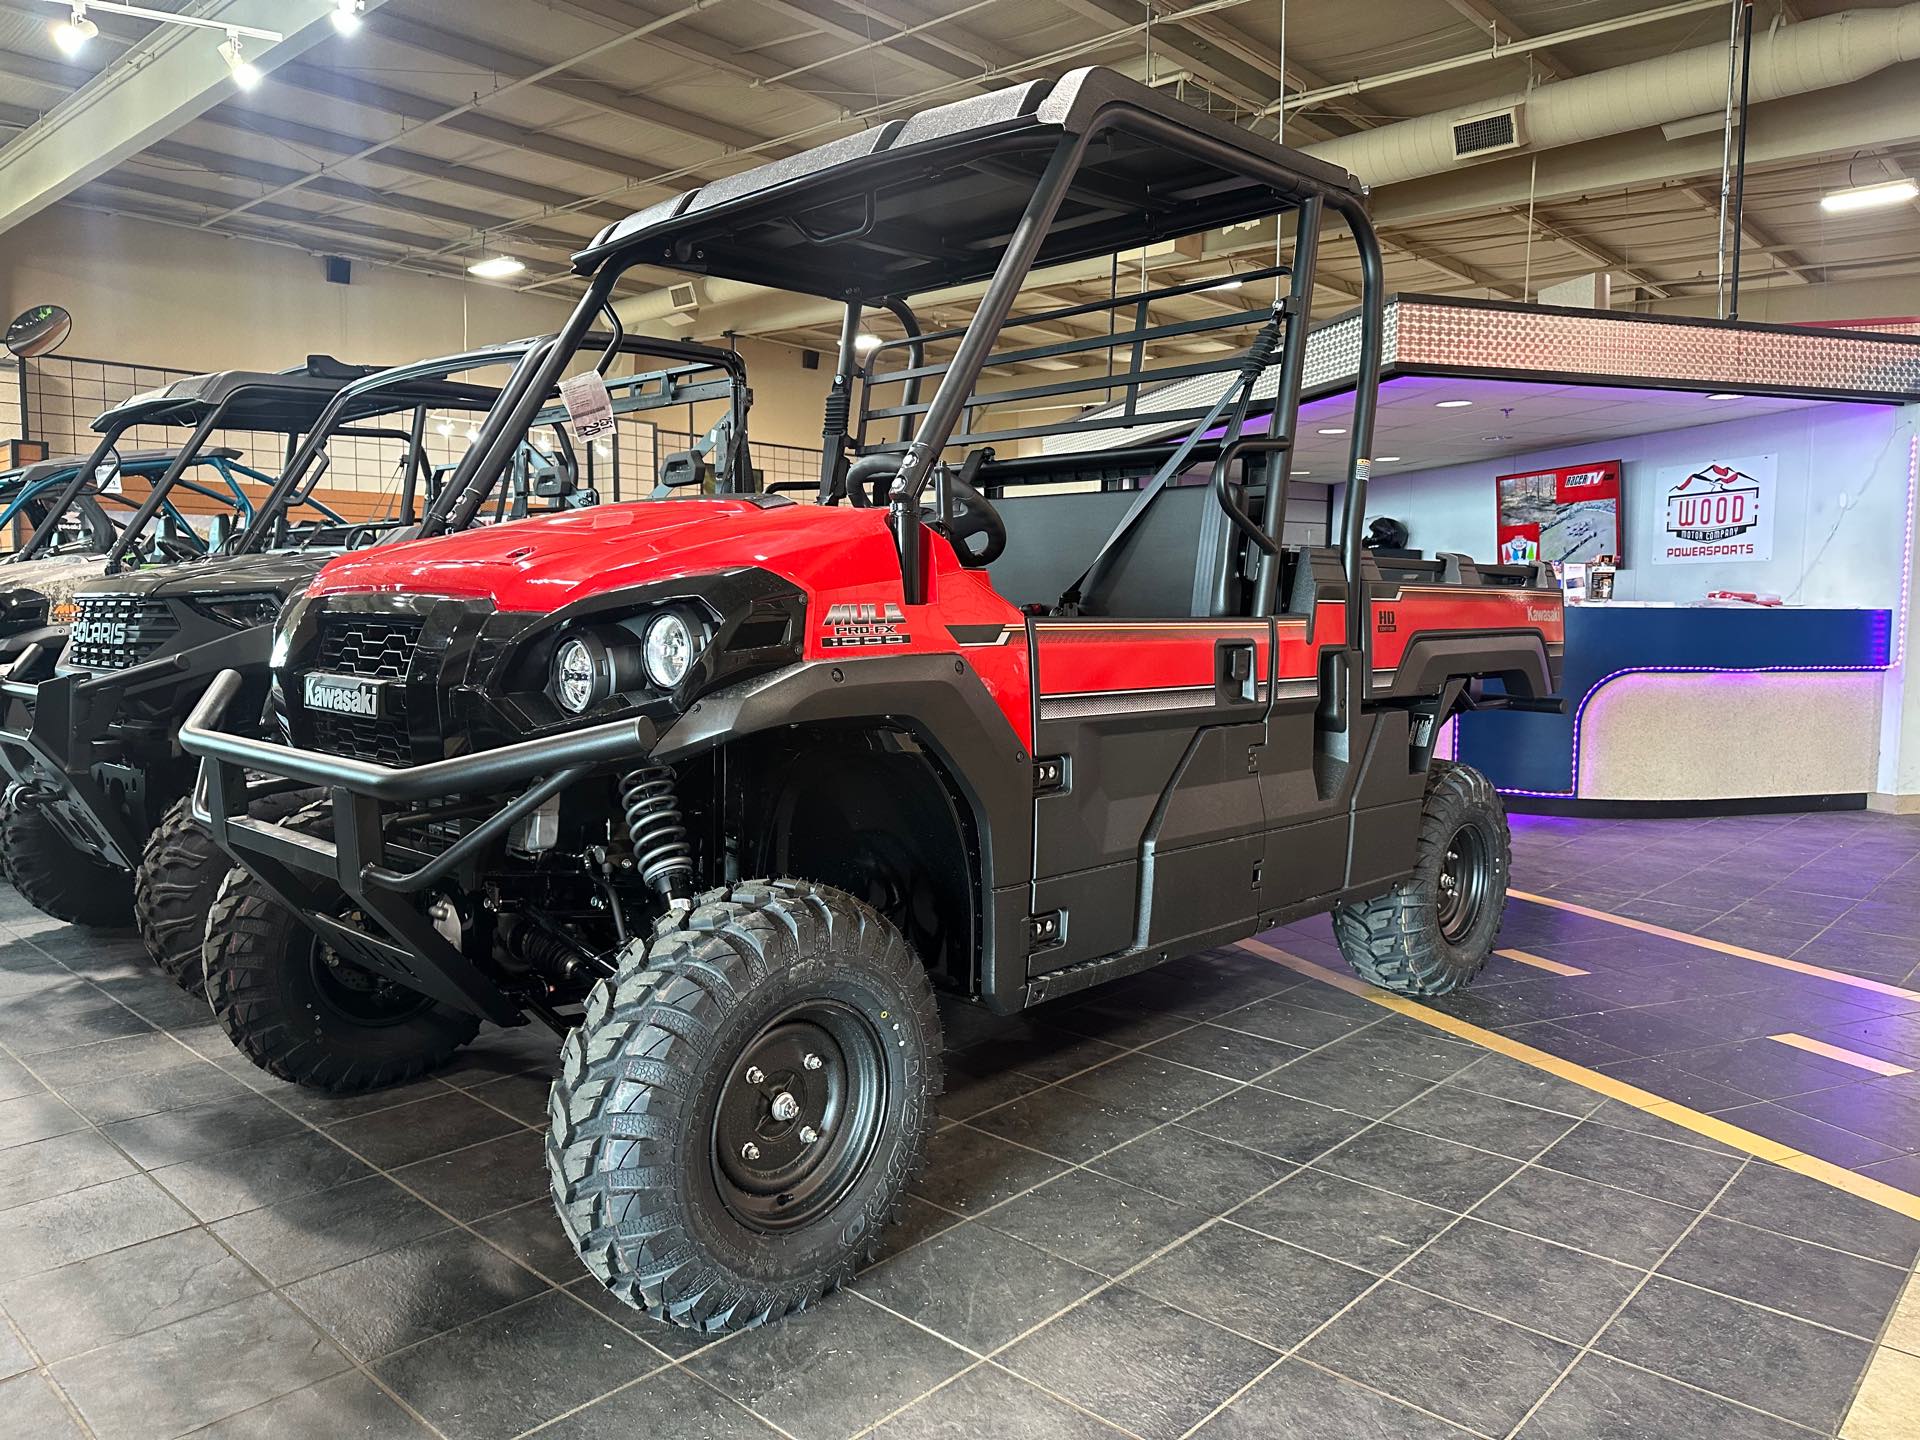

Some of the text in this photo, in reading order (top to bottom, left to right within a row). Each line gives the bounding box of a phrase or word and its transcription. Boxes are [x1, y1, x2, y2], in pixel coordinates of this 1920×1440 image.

[1678, 495, 1745, 527] WOOD
[1680, 526, 1739, 541] MOTOR COMPANY
[1666, 543, 1755, 558] POWERSPORTS
[823, 603, 907, 626] MULE
[1378, 610, 1395, 625] HD
[1526, 605, 1561, 622] Kawasaki
[69, 621, 127, 645] POLARIS
[834, 624, 897, 635] PRO-FX
[830, 635, 904, 647] 1000
[305, 676, 377, 715] Kawasaki
